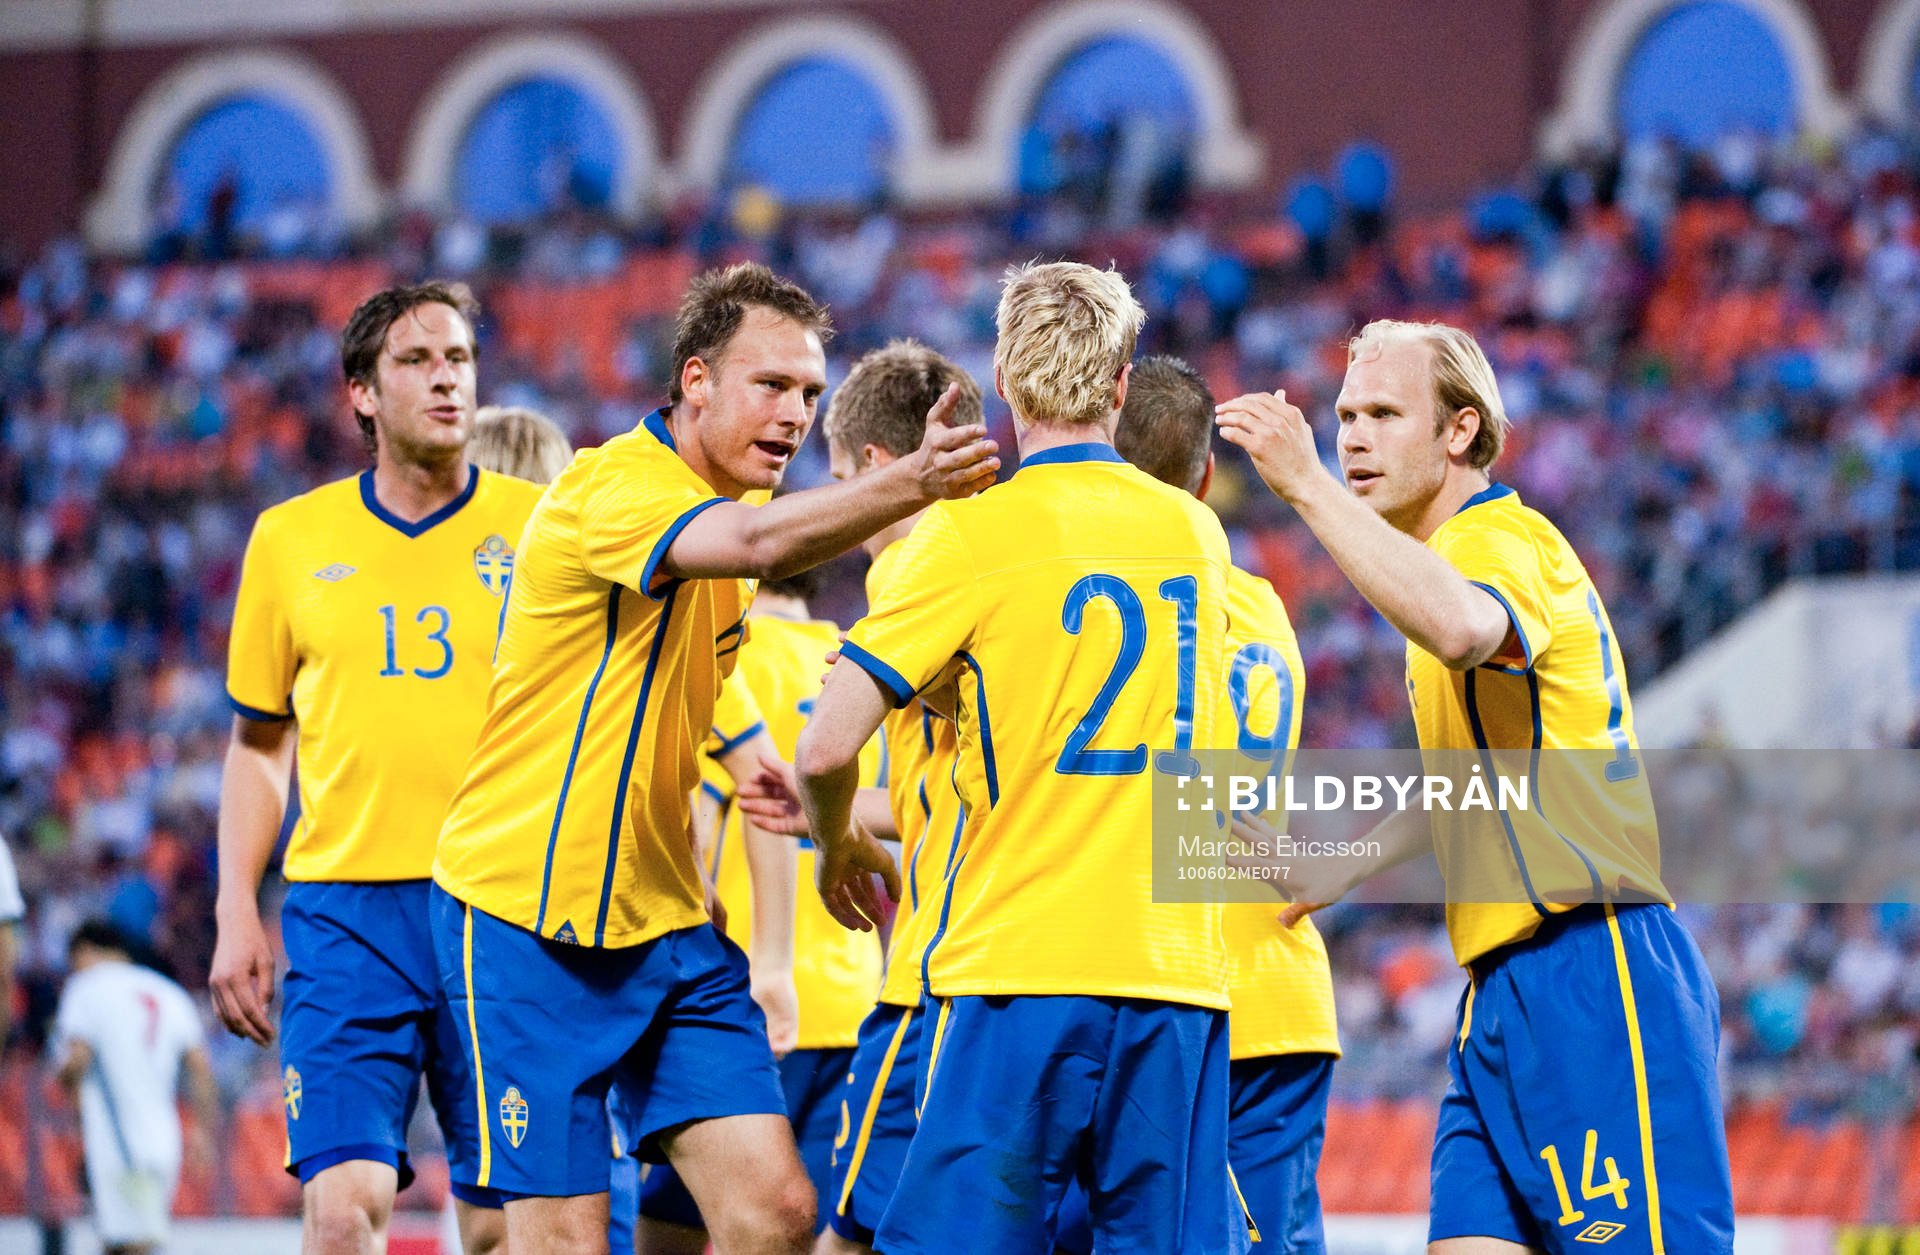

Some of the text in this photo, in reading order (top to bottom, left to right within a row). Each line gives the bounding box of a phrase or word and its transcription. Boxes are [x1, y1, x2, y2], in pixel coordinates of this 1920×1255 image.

[378, 605, 454, 680] 13
[1055, 573, 1200, 779] 21
[1540, 1129, 1631, 1227] 14
